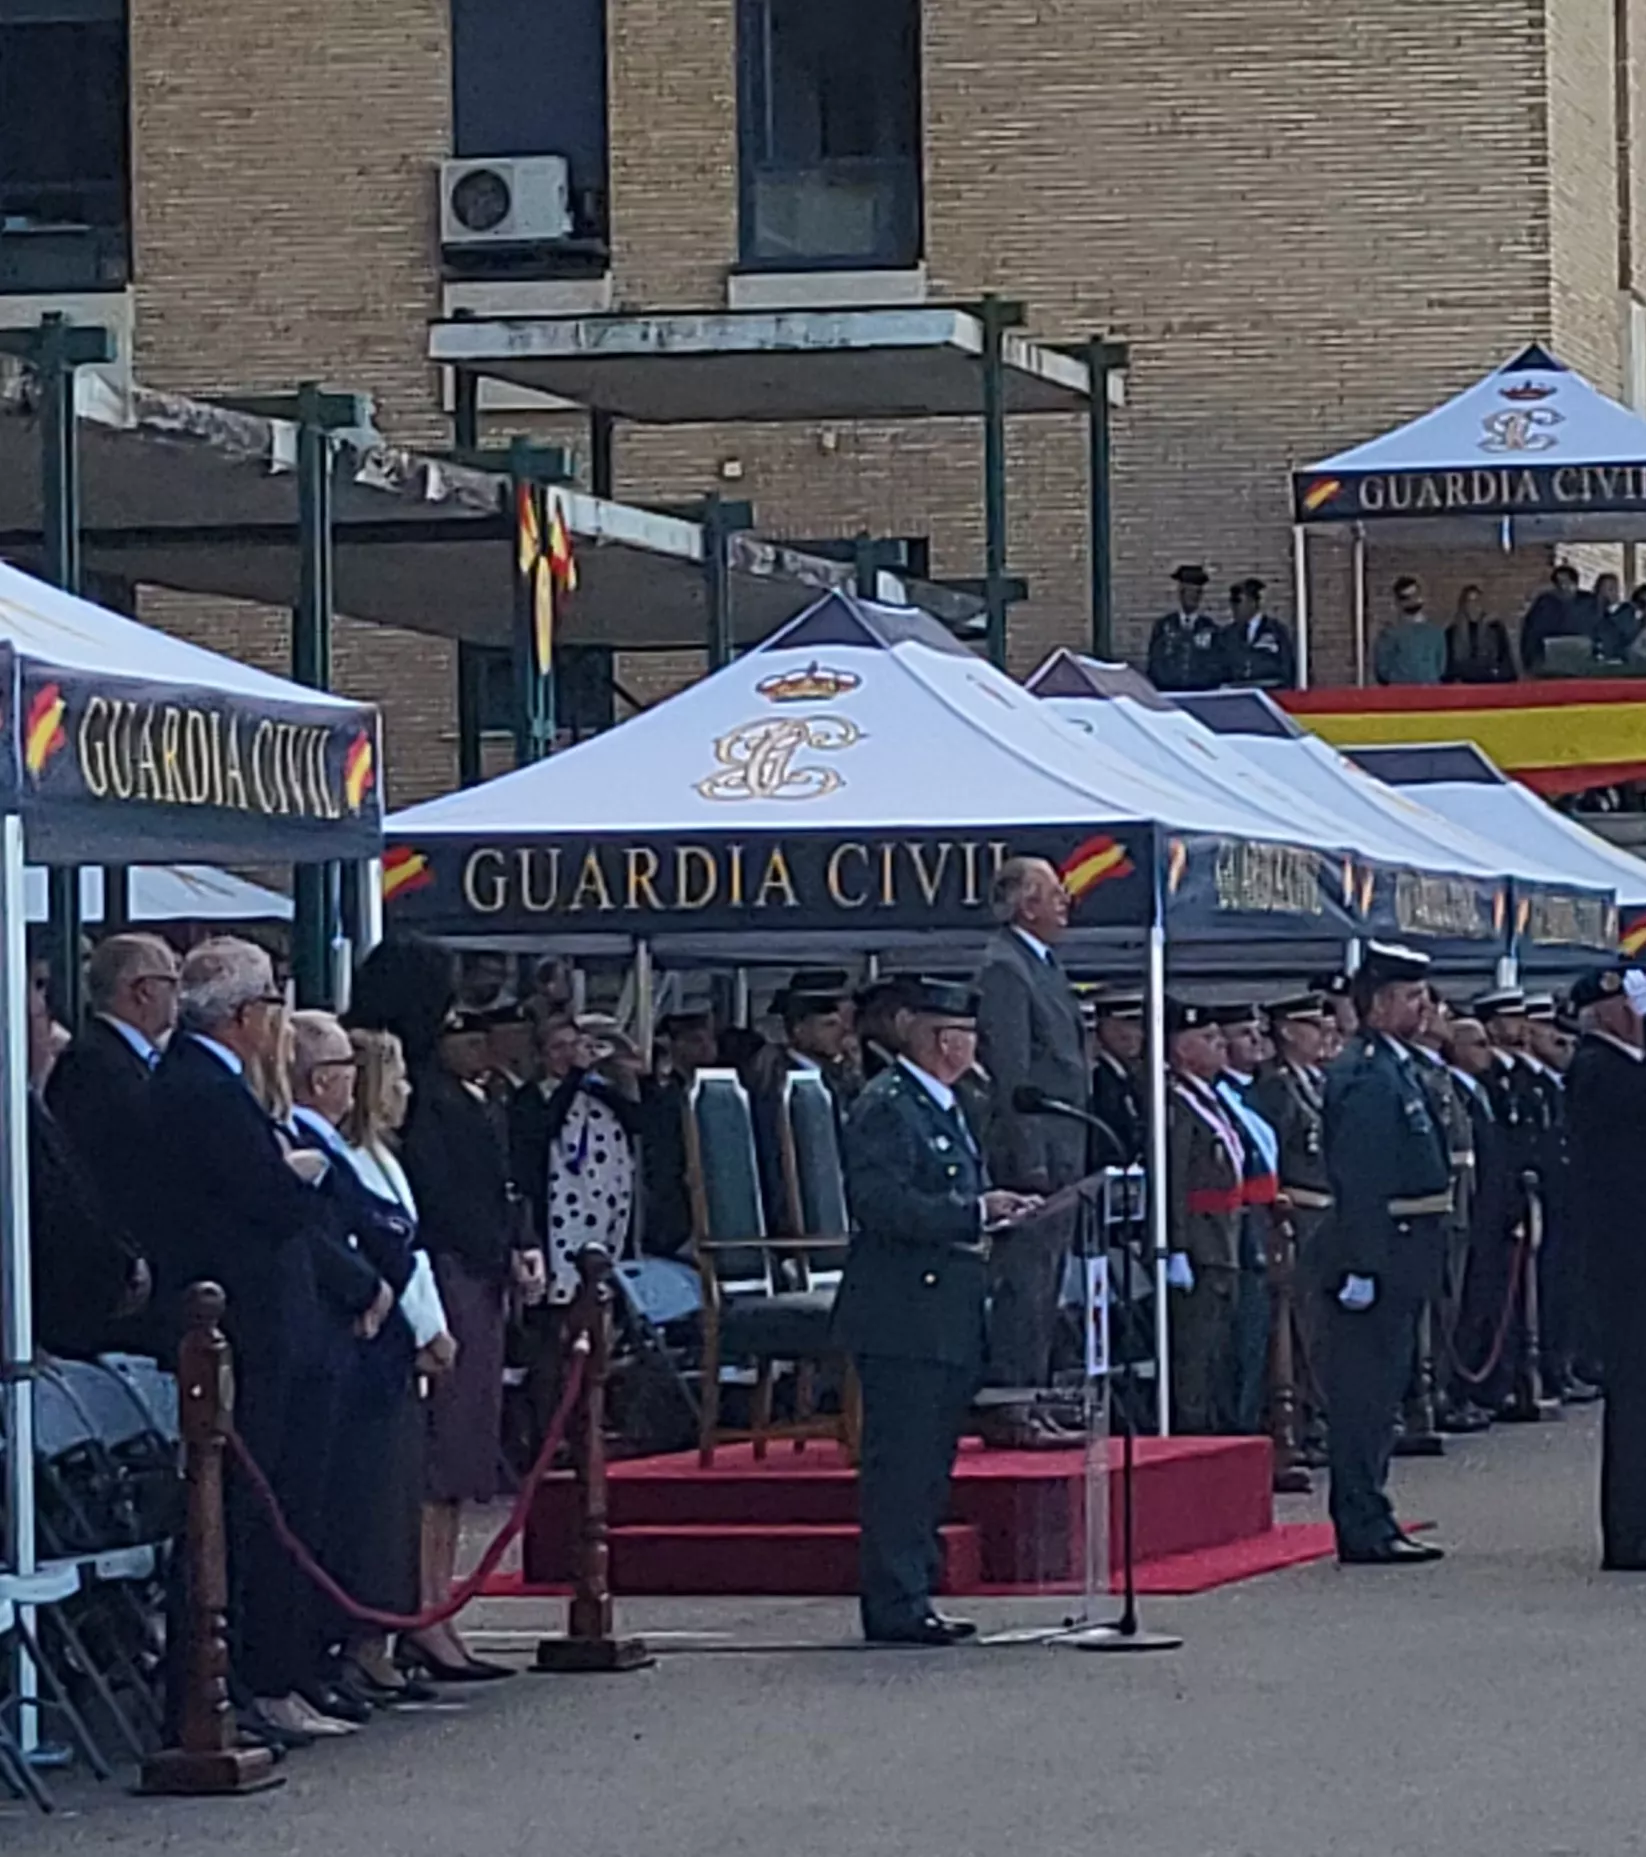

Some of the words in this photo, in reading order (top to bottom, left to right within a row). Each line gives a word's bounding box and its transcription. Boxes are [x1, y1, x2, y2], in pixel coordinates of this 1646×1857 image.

[1359, 471, 1539, 509] GUARDIA
[79, 696, 249, 809] GUARDIA
[252, 719, 342, 819] CIVIL
[464, 846, 799, 911] GUARDIA
